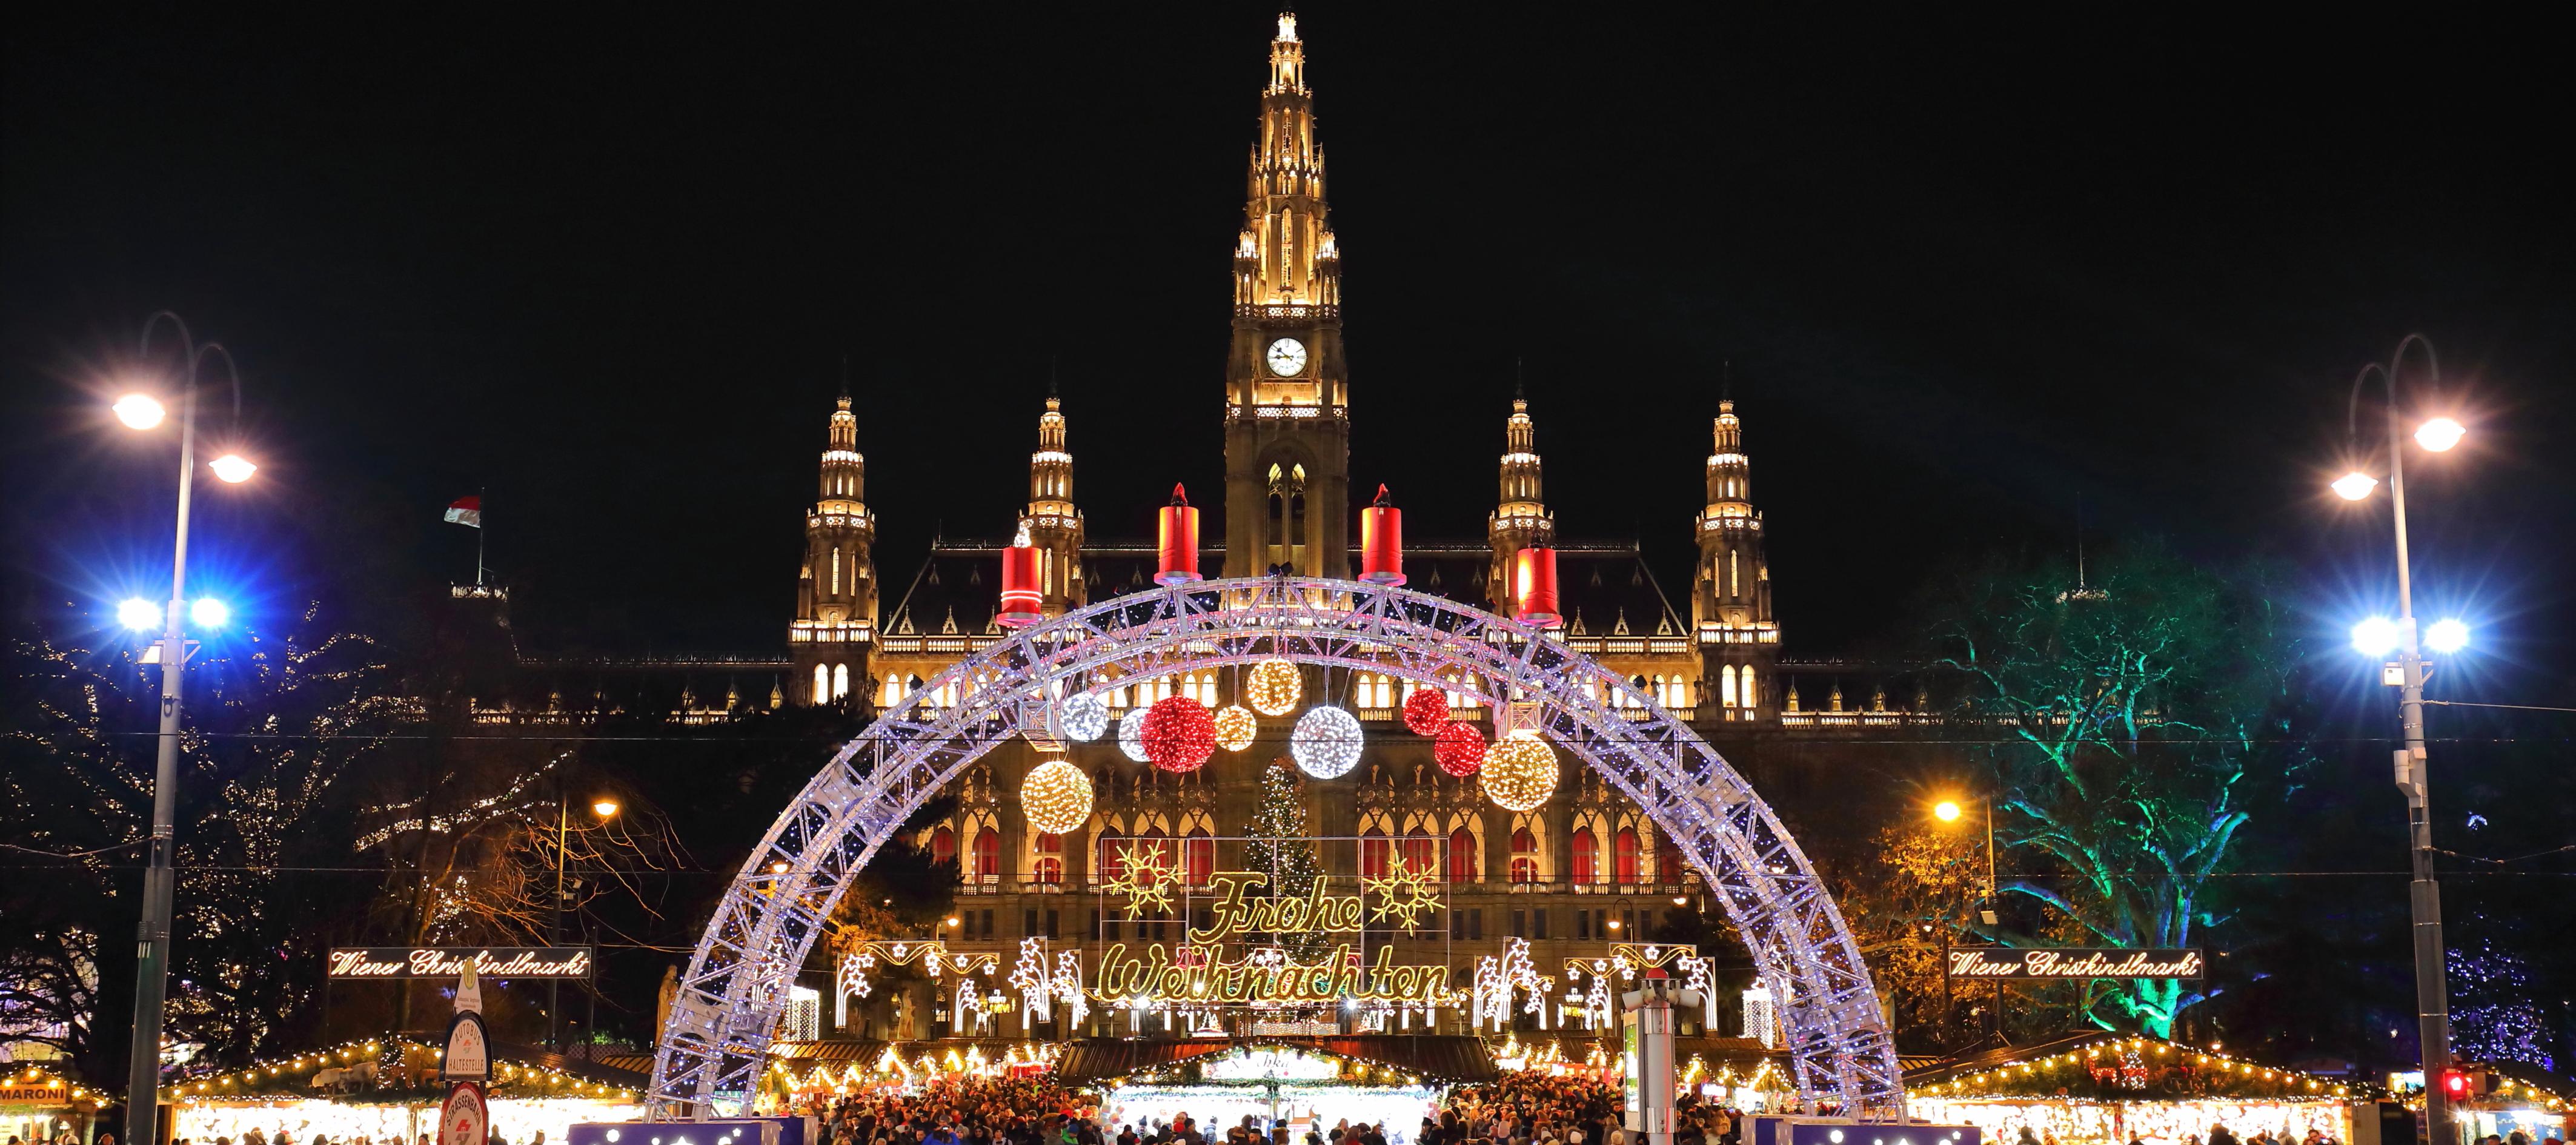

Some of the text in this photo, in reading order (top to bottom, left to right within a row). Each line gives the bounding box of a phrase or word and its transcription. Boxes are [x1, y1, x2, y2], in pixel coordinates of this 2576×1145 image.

[1189, 871, 1363, 944] Frohe
[331, 949, 589, 975] Wiener Chriskindlmarkt
[1098, 943, 1451, 1002] Weihnachten
[1950, 950, 2200, 975] Wiener Christkindlmarkt
[455, 1023, 481, 1046] AUTOBUS
[448, 1058, 484, 1071] HALTESTELLE
[0, 1089, 64, 1100] MARONI
[446, 1095, 482, 1127] STRASSENBAHN
